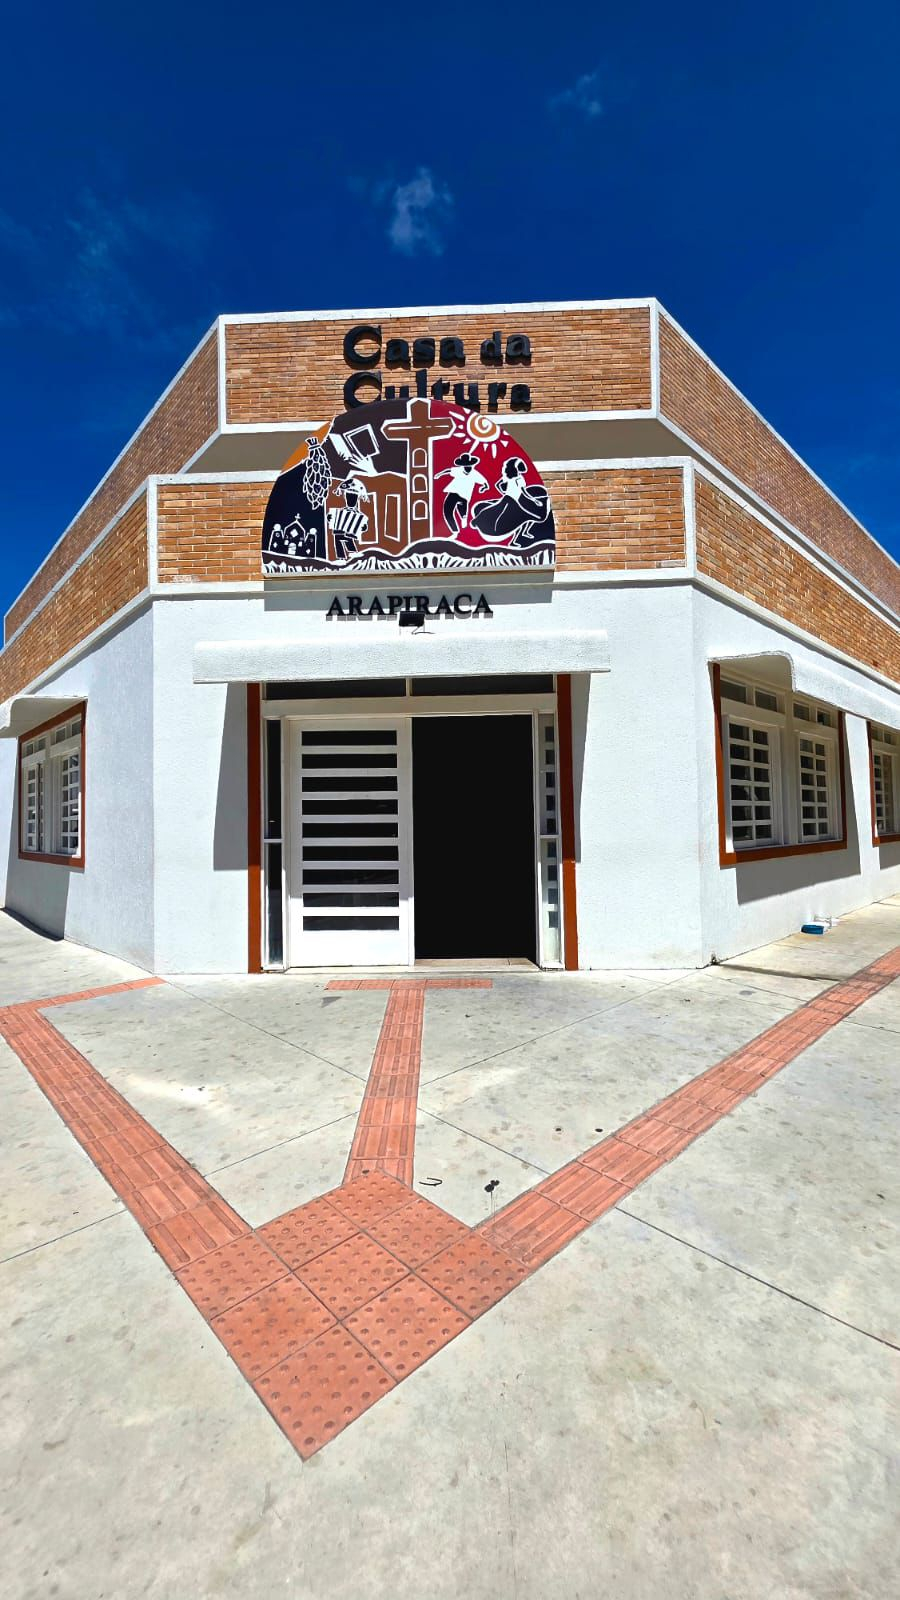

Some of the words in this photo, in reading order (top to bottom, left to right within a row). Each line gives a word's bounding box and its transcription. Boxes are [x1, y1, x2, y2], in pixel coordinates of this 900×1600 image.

[343, 325, 465, 369] Casa
[480, 331, 532, 366] da
[343, 370, 531, 412] Cultura
[326, 594, 493, 617] ARAPIRACA
